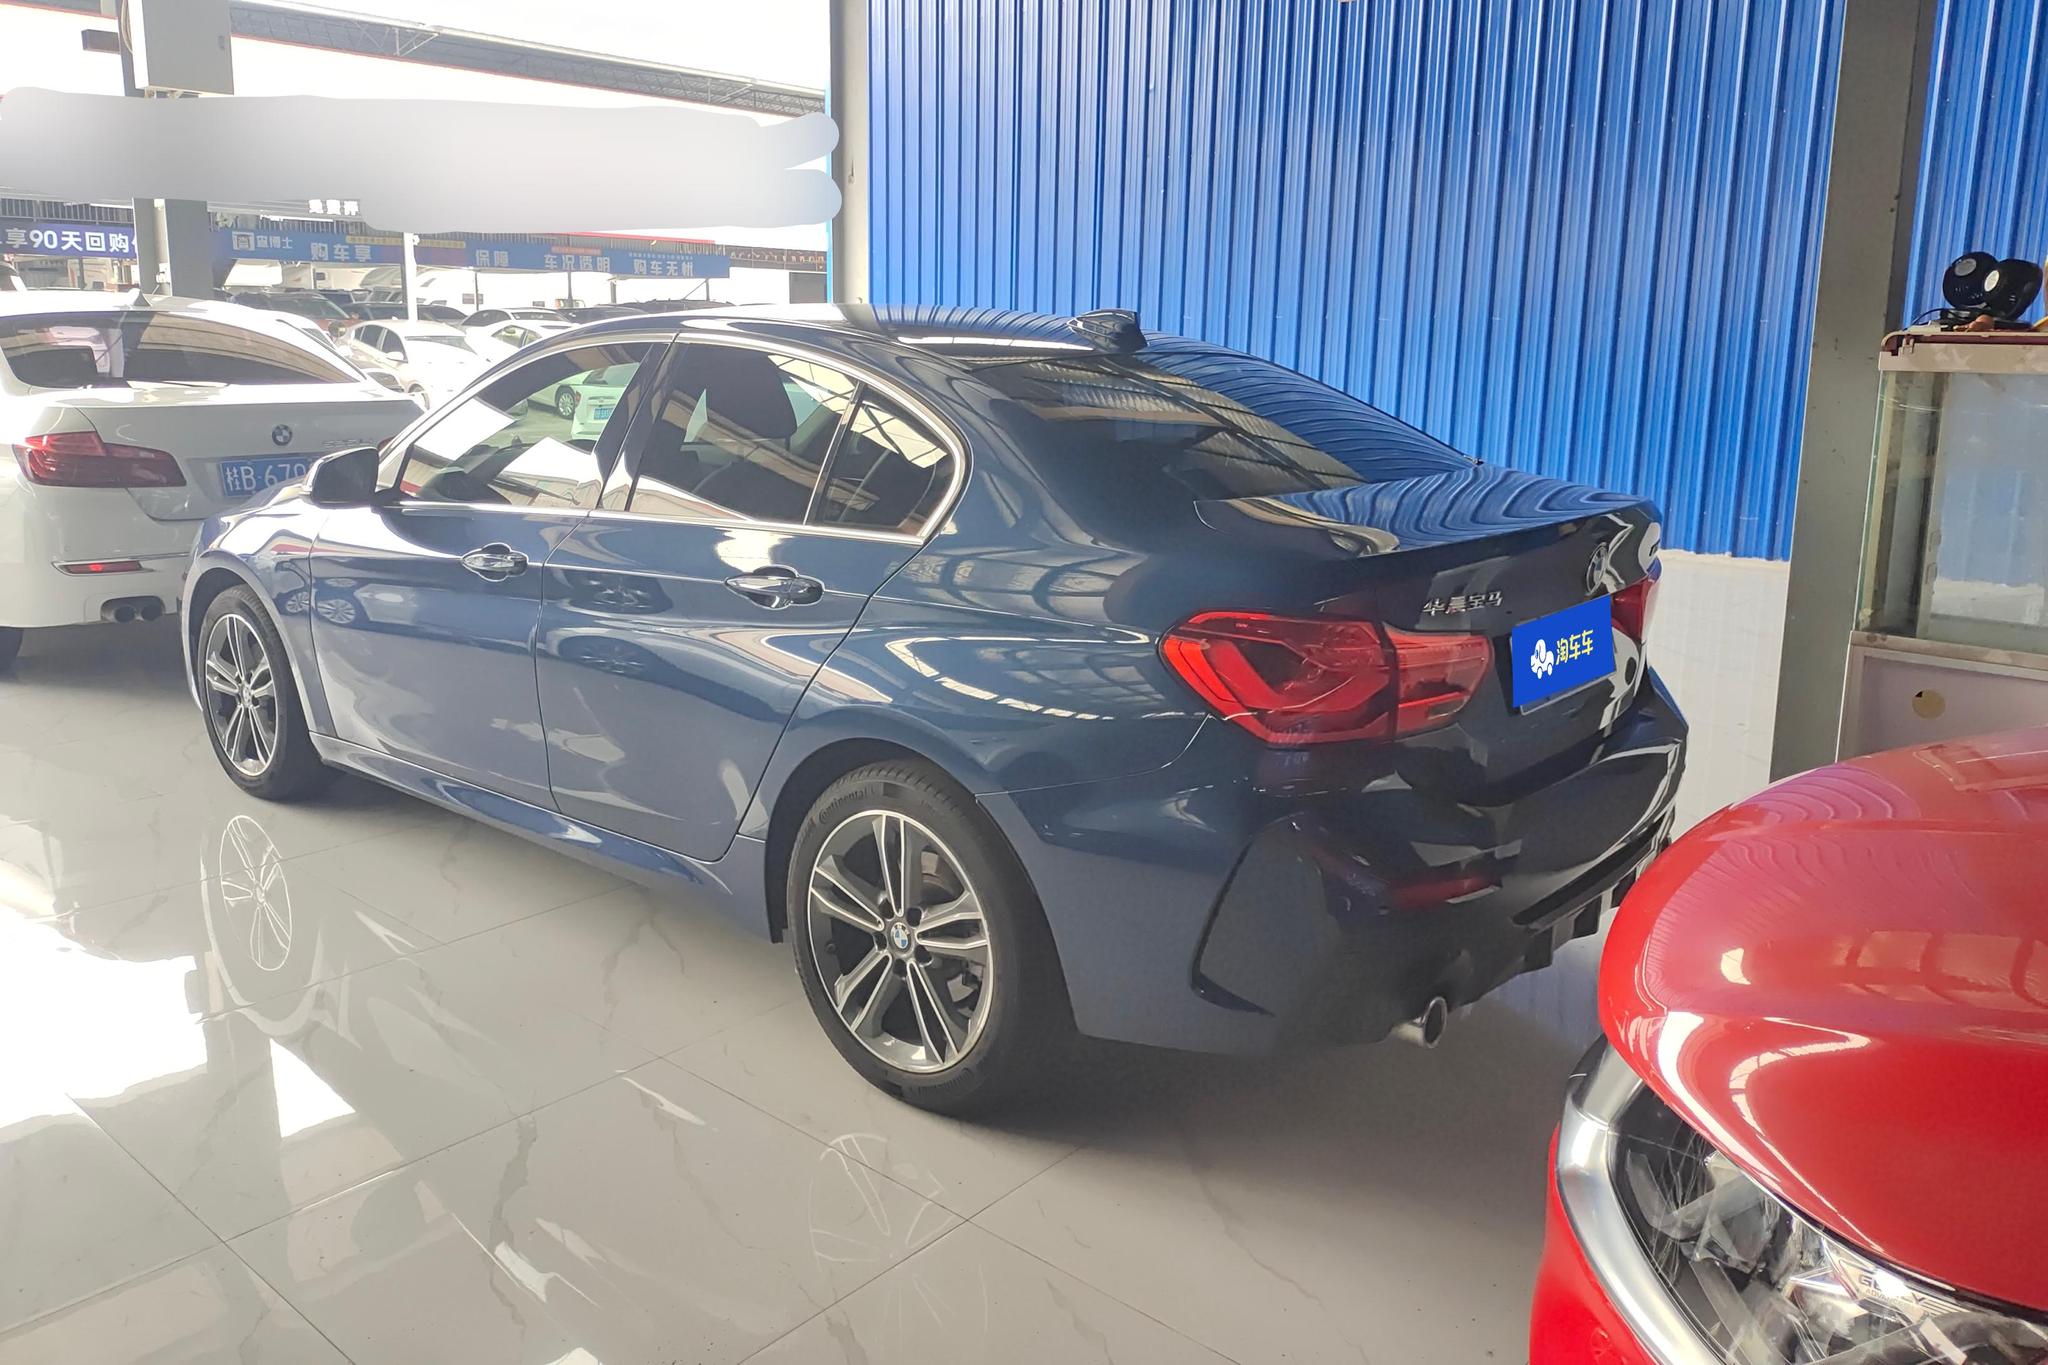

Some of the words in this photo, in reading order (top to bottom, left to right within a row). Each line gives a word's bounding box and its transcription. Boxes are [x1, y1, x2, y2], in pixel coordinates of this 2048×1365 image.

[5, 228, 137, 253] 享90天回购
[1422, 591, 1503, 616] 华晨宝马
